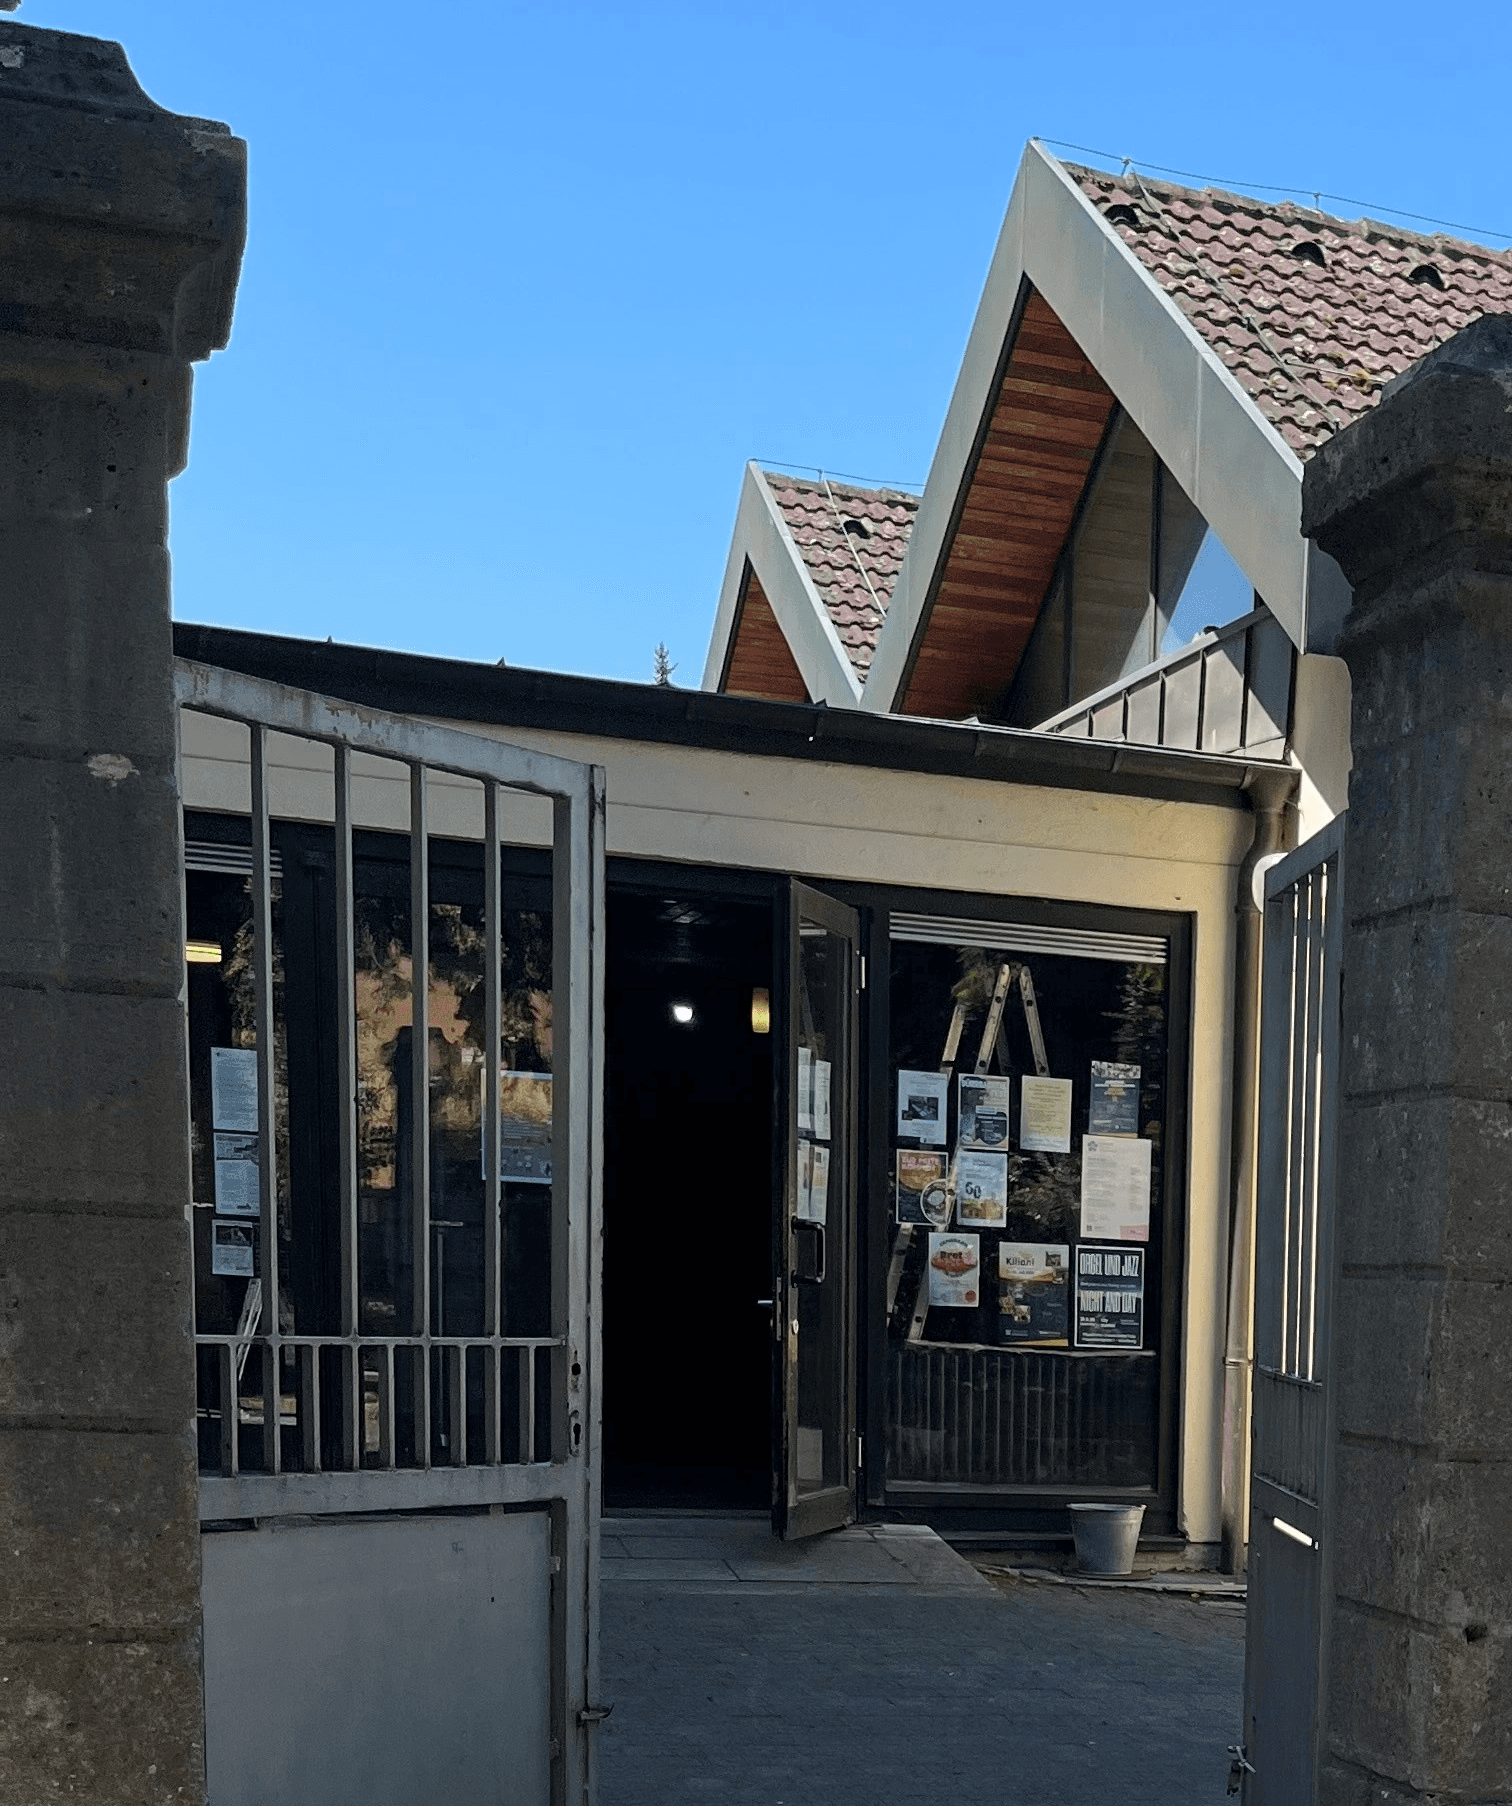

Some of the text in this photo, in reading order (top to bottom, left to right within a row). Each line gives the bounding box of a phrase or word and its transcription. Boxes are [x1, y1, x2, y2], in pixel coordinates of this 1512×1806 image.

[1104, 1253, 1121, 1276] UND
[1121, 1255, 1140, 1277] JAZZ
[1079, 1289, 1104, 1313] NIGHT
[1104, 1290, 1121, 1313] AND
